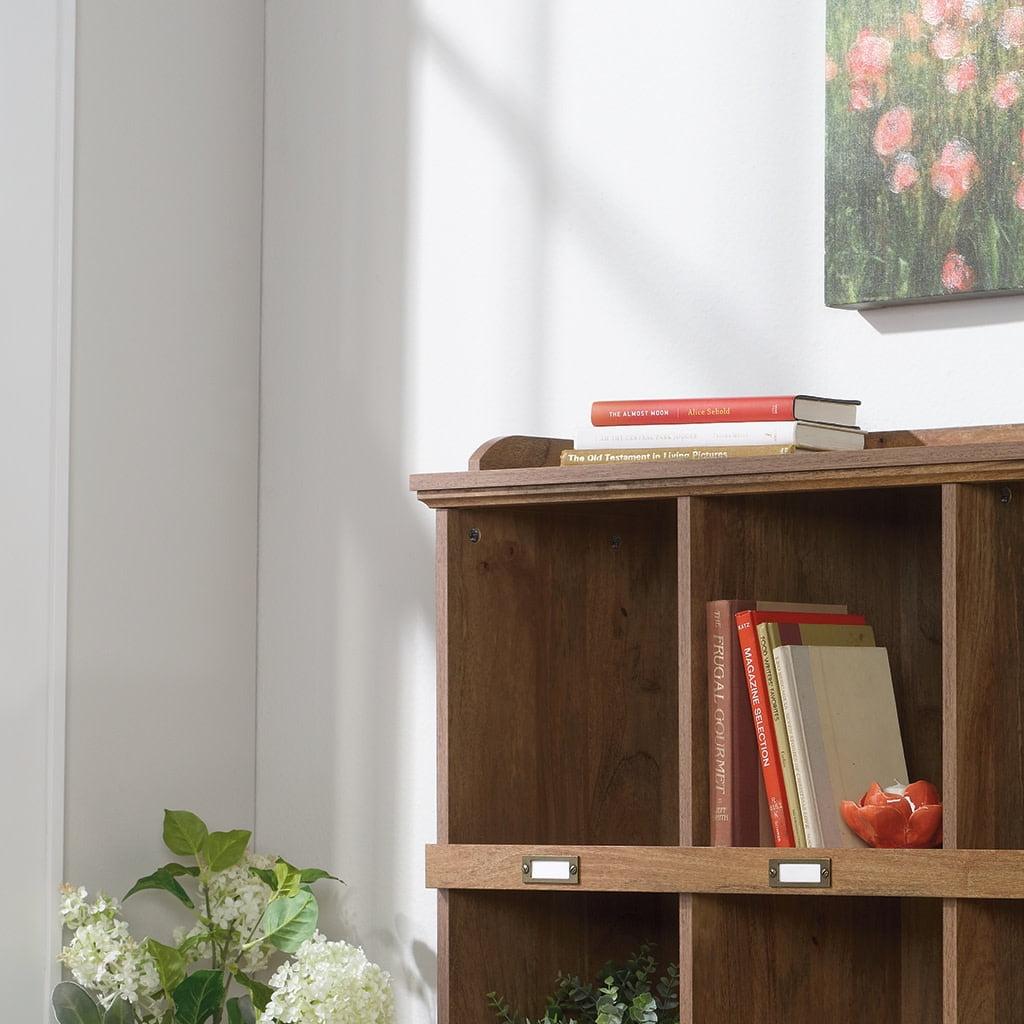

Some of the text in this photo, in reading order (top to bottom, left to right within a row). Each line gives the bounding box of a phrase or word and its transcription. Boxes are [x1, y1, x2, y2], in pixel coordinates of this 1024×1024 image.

[688, 408, 704, 416] Alice
[706, 407, 731, 415] Sebold
[568, 450, 728, 462] The Old Testament in Living Pictures
[713, 635, 725, 703] FRUGAL
[743, 647, 770, 767] MAGAZINE SELECTION
[760, 635, 768, 657] FOOD
[768, 686, 780, 721] FAVORITES
[714, 708, 726, 795] GOURMET
